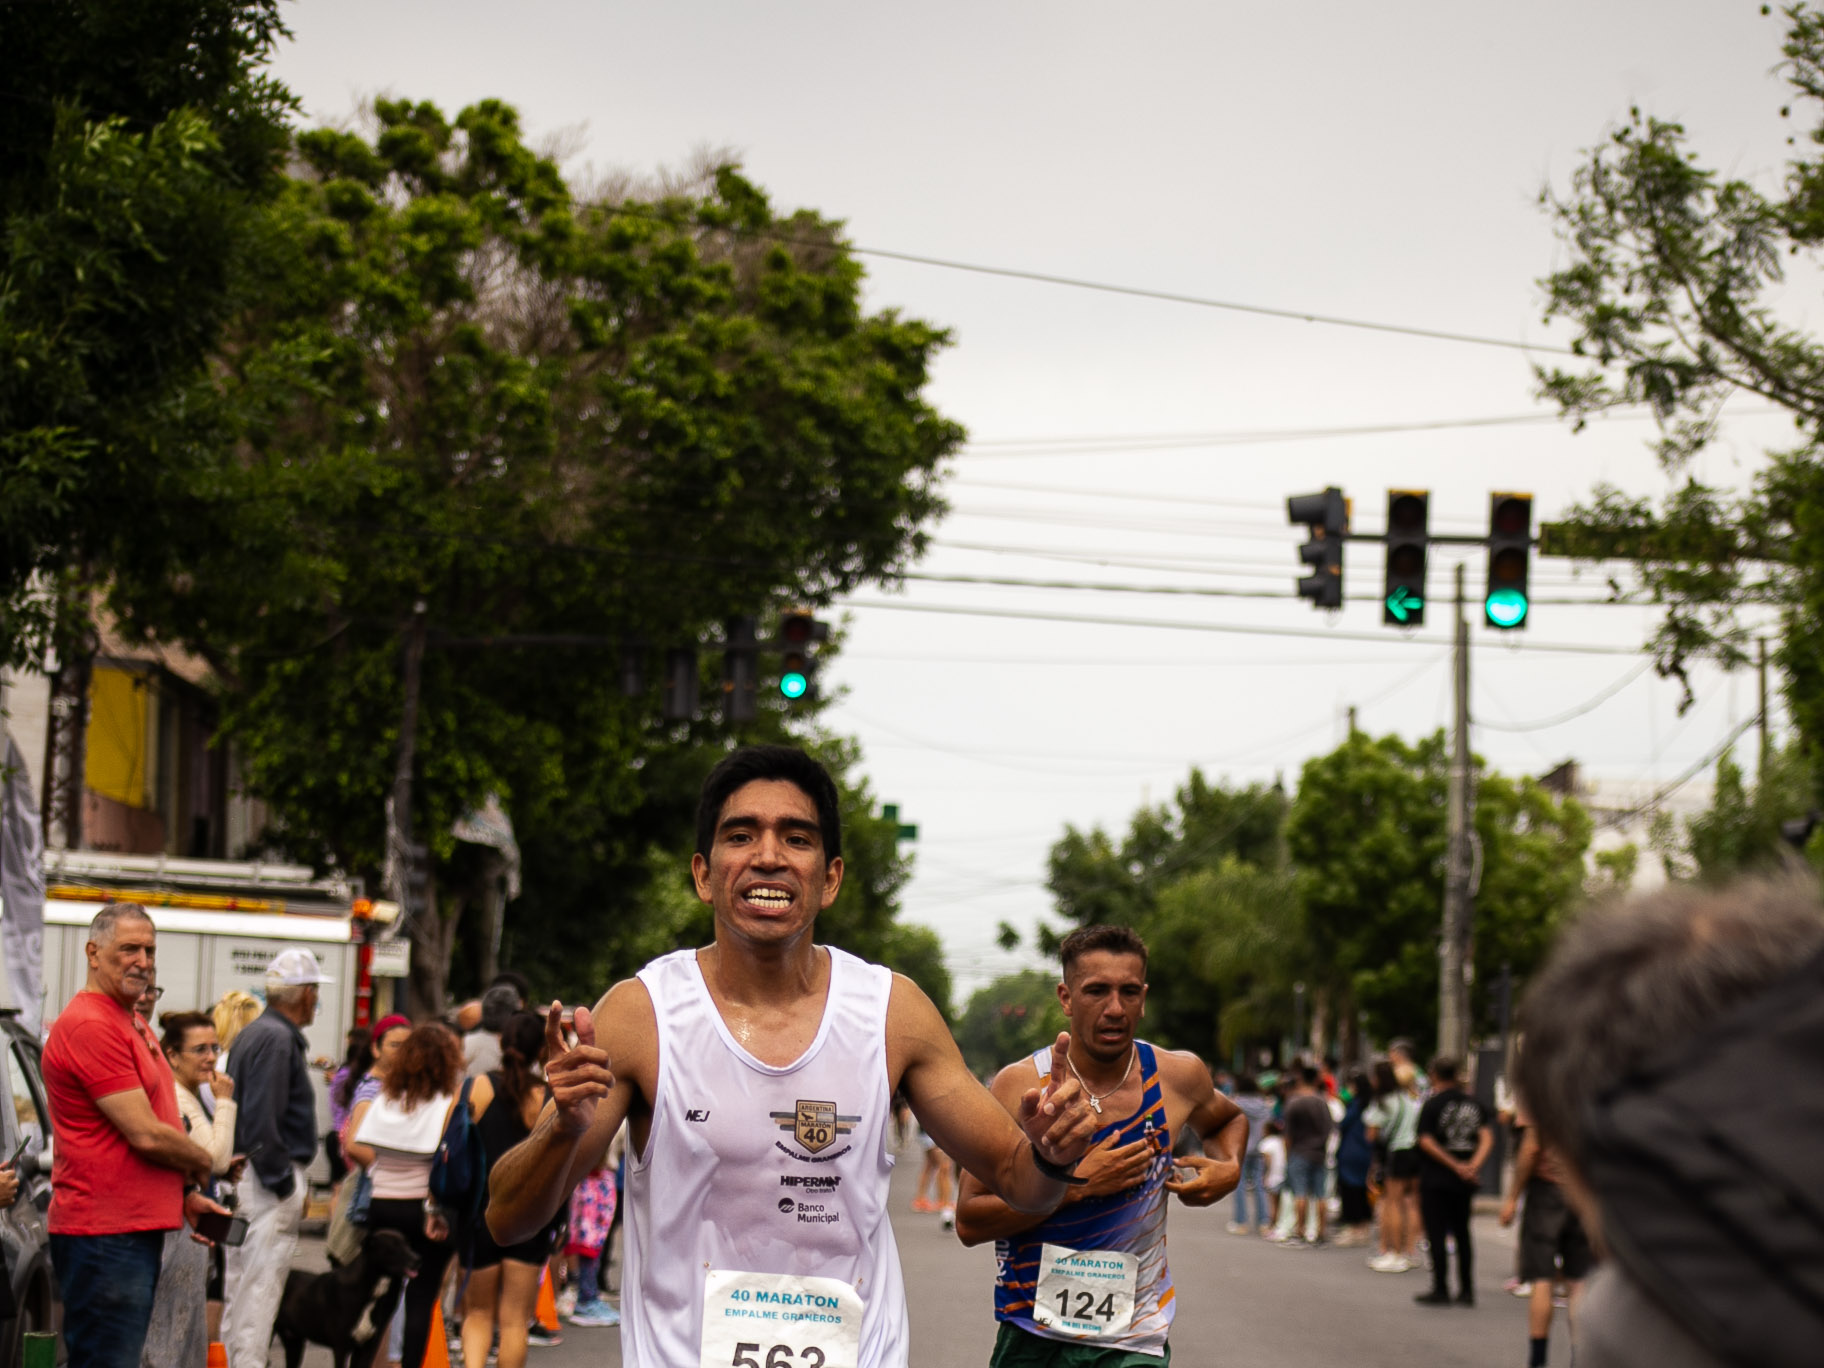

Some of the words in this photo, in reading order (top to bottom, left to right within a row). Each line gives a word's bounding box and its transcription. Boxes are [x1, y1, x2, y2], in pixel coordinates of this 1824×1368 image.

[685, 1109, 710, 1122] NEJ
[804, 1128, 827, 1143] 40
[775, 1141, 811, 1162] EMPALME
[798, 1203, 825, 1212] Banco
[797, 1212, 840, 1224] Municipal
[1071, 1258, 1123, 1269] MARATON
[1051, 1268, 1085, 1277] EMPALME
[1087, 1272, 1125, 1280] GRANEROS
[731, 1289, 750, 1301] 40
[756, 1291, 839, 1309] MARATON
[1056, 1289, 1114, 1322] 124
[725, 1308, 778, 1319] EMPALME
[782, 1312, 842, 1323] GRANEROS
